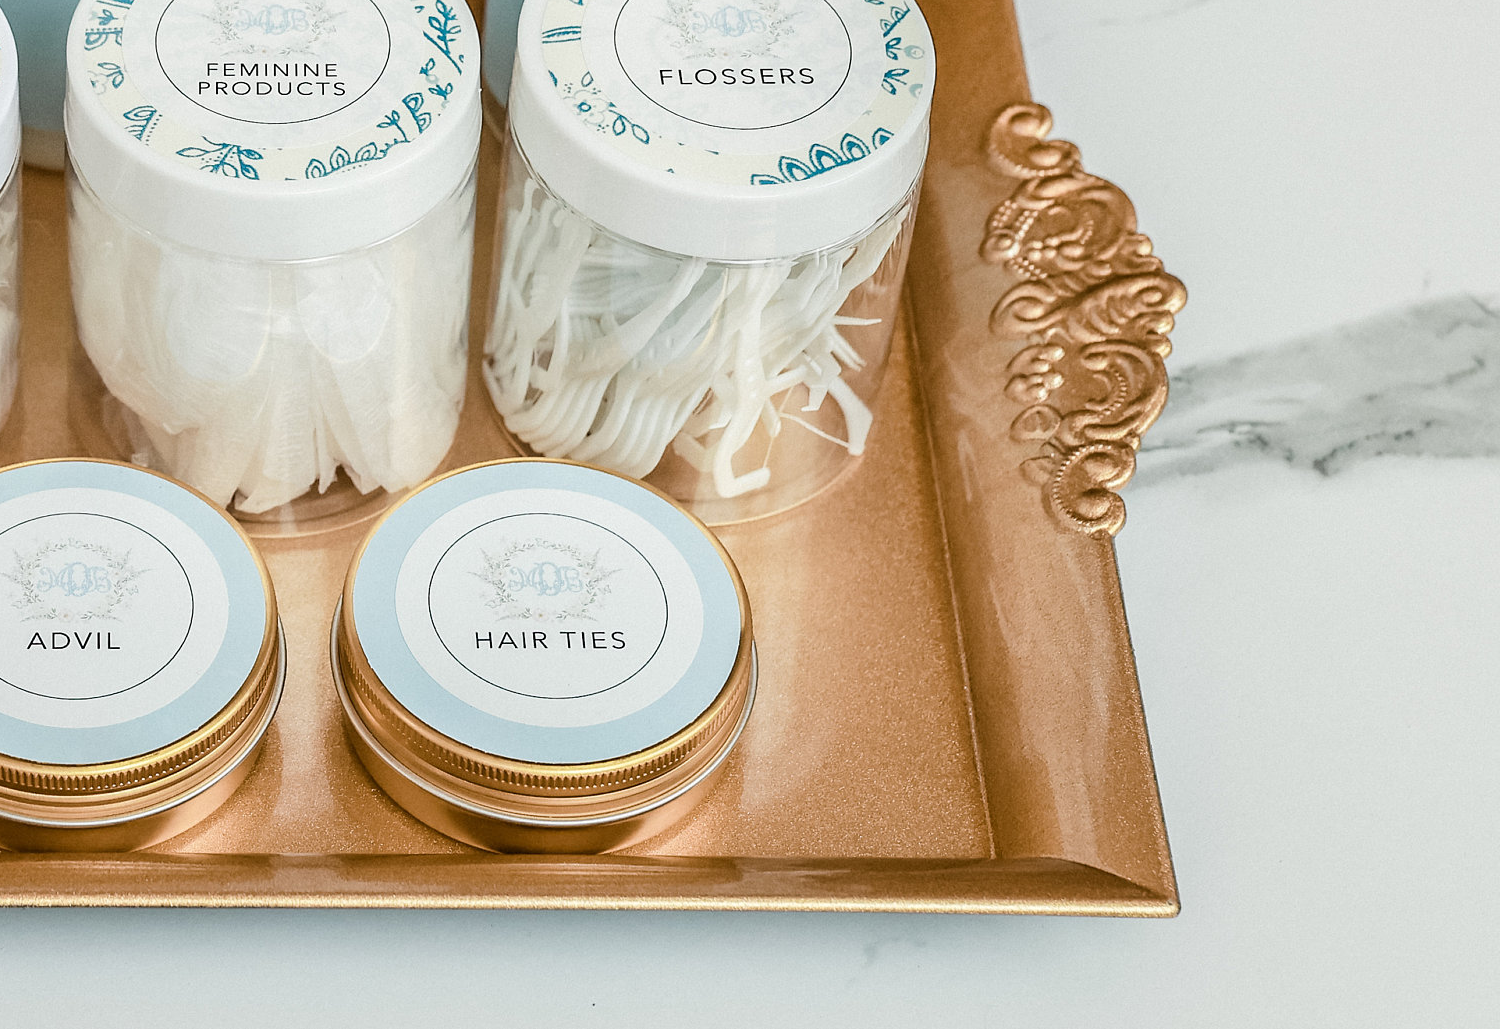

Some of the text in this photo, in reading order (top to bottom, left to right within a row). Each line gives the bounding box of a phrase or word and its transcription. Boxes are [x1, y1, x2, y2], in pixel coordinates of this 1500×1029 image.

[208, 63, 337, 77] FEMININE
[660, 68, 814, 85] FLOSSERS
[199, 82, 345, 95] PRODUCTS
[27, 632, 120, 649] ADVIL
[476, 632, 625, 649] HAIR TIES
